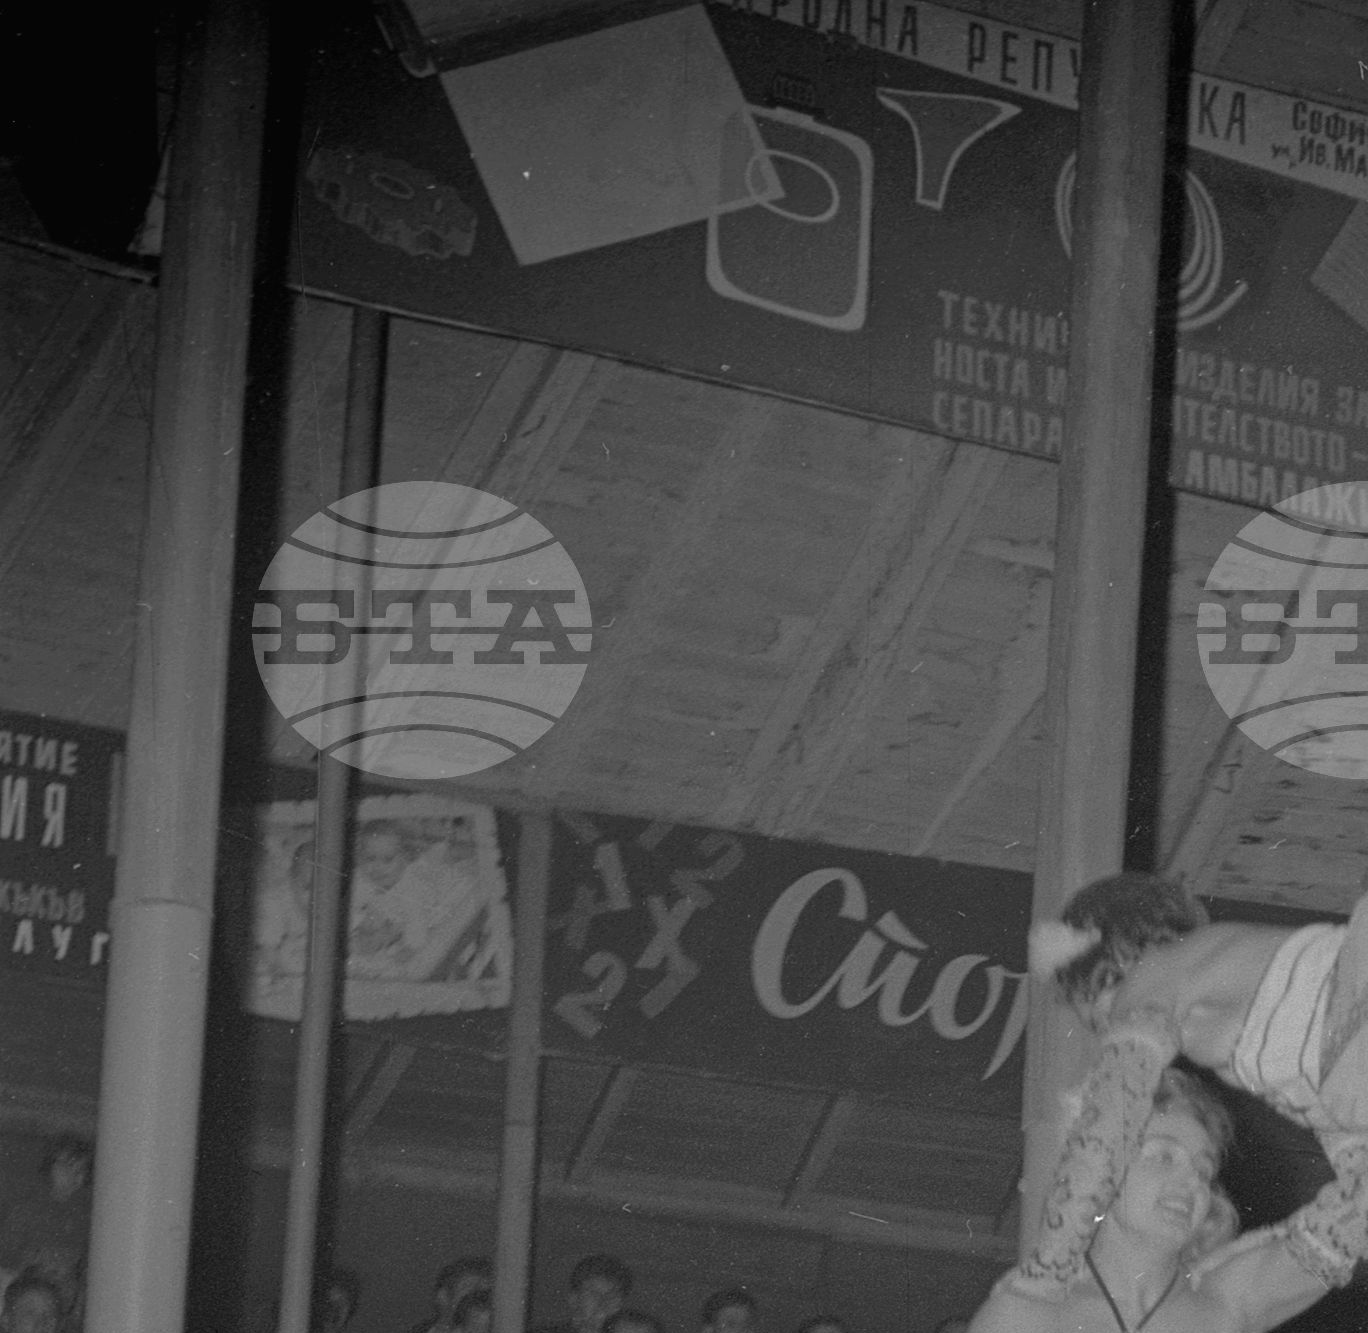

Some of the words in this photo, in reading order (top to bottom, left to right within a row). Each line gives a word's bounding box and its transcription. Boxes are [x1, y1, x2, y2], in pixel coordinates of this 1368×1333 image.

[933, 338, 1030, 399] НОСТА
[937, 289, 1070, 354] ТЕХНИ
[1176, 347, 1321, 417] ИЗДЕЛИЯ
